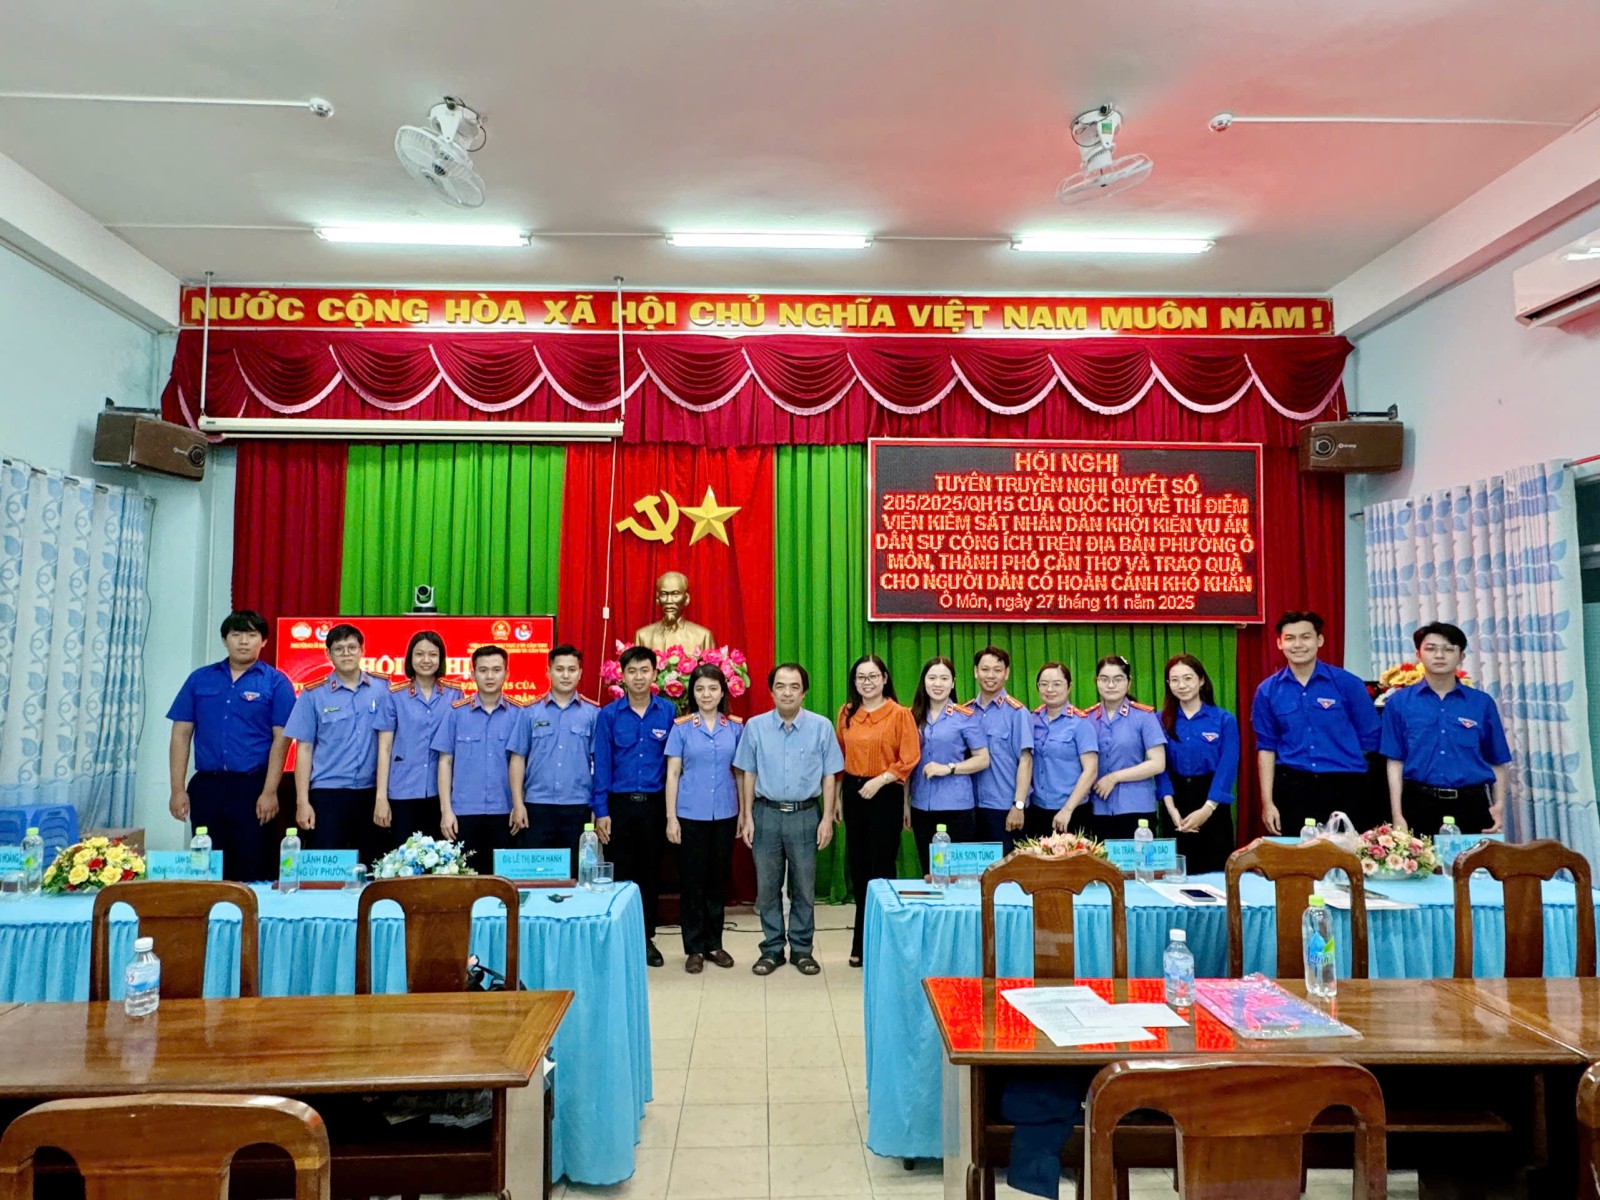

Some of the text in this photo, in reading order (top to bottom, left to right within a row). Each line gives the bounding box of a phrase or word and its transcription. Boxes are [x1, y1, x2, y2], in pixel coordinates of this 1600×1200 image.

[191, 290, 304, 321] NƯỚC
[317, 292, 429, 328] CỘNG
[445, 293, 526, 324] HÒA
[543, 294, 597, 325] XÃ
[611, 295, 676, 330] HỘI
[689, 294, 765, 327] CHỦ
[778, 297, 896, 328] NGHĨA
[907, 299, 989, 332] VIỆT
[1003, 304, 1088, 329] NAM
[1100, 301, 1208, 329] MUÔN
[1015, 451, 1119, 476] HỘI NGHỊ
[935, 471, 1200, 496] TUYÊN TRUYỀN NGHỊ QUYẾT SỐ
[883, 492, 1249, 515] 205/2025/QH15 CỦA QUỐC HỘI VỀ THÍ ĐIỂM
[881, 513, 923, 532] VIỆN
[928, 511, 971, 531] KIỂM
[974, 512, 1009, 531] SÁT
[1013, 513, 1062, 532] NHÂN
[1066, 514, 1102, 532] DÂN
[1153, 516, 1192, 535] KIỆN
[1195, 517, 1220, 535] VỤ
[1224, 514, 1249, 533] ÁN
[876, 531, 1255, 554] DÂN SỰ CÔNG ÍCH TRÊN ĐỊA BÀN PHƯỜNG Ô
[886, 551, 1243, 572] MÔN, THÀNH PHỐ CẦN THƠ VÀ TRAO QUÀ
[879, 573, 919, 590] CHO
[923, 570, 983, 590] NGƯỜI
[987, 571, 1024, 590] DÂN
[1028, 570, 1053, 590] CÓ
[1057, 571, 1108, 591] HOÀN
[1111, 571, 1159, 591] CẢNH
[1162, 572, 1200, 592] KHÓ
[939, 589, 1195, 612] Ô Môn, ngày 27 tháng 11 năm 2025
